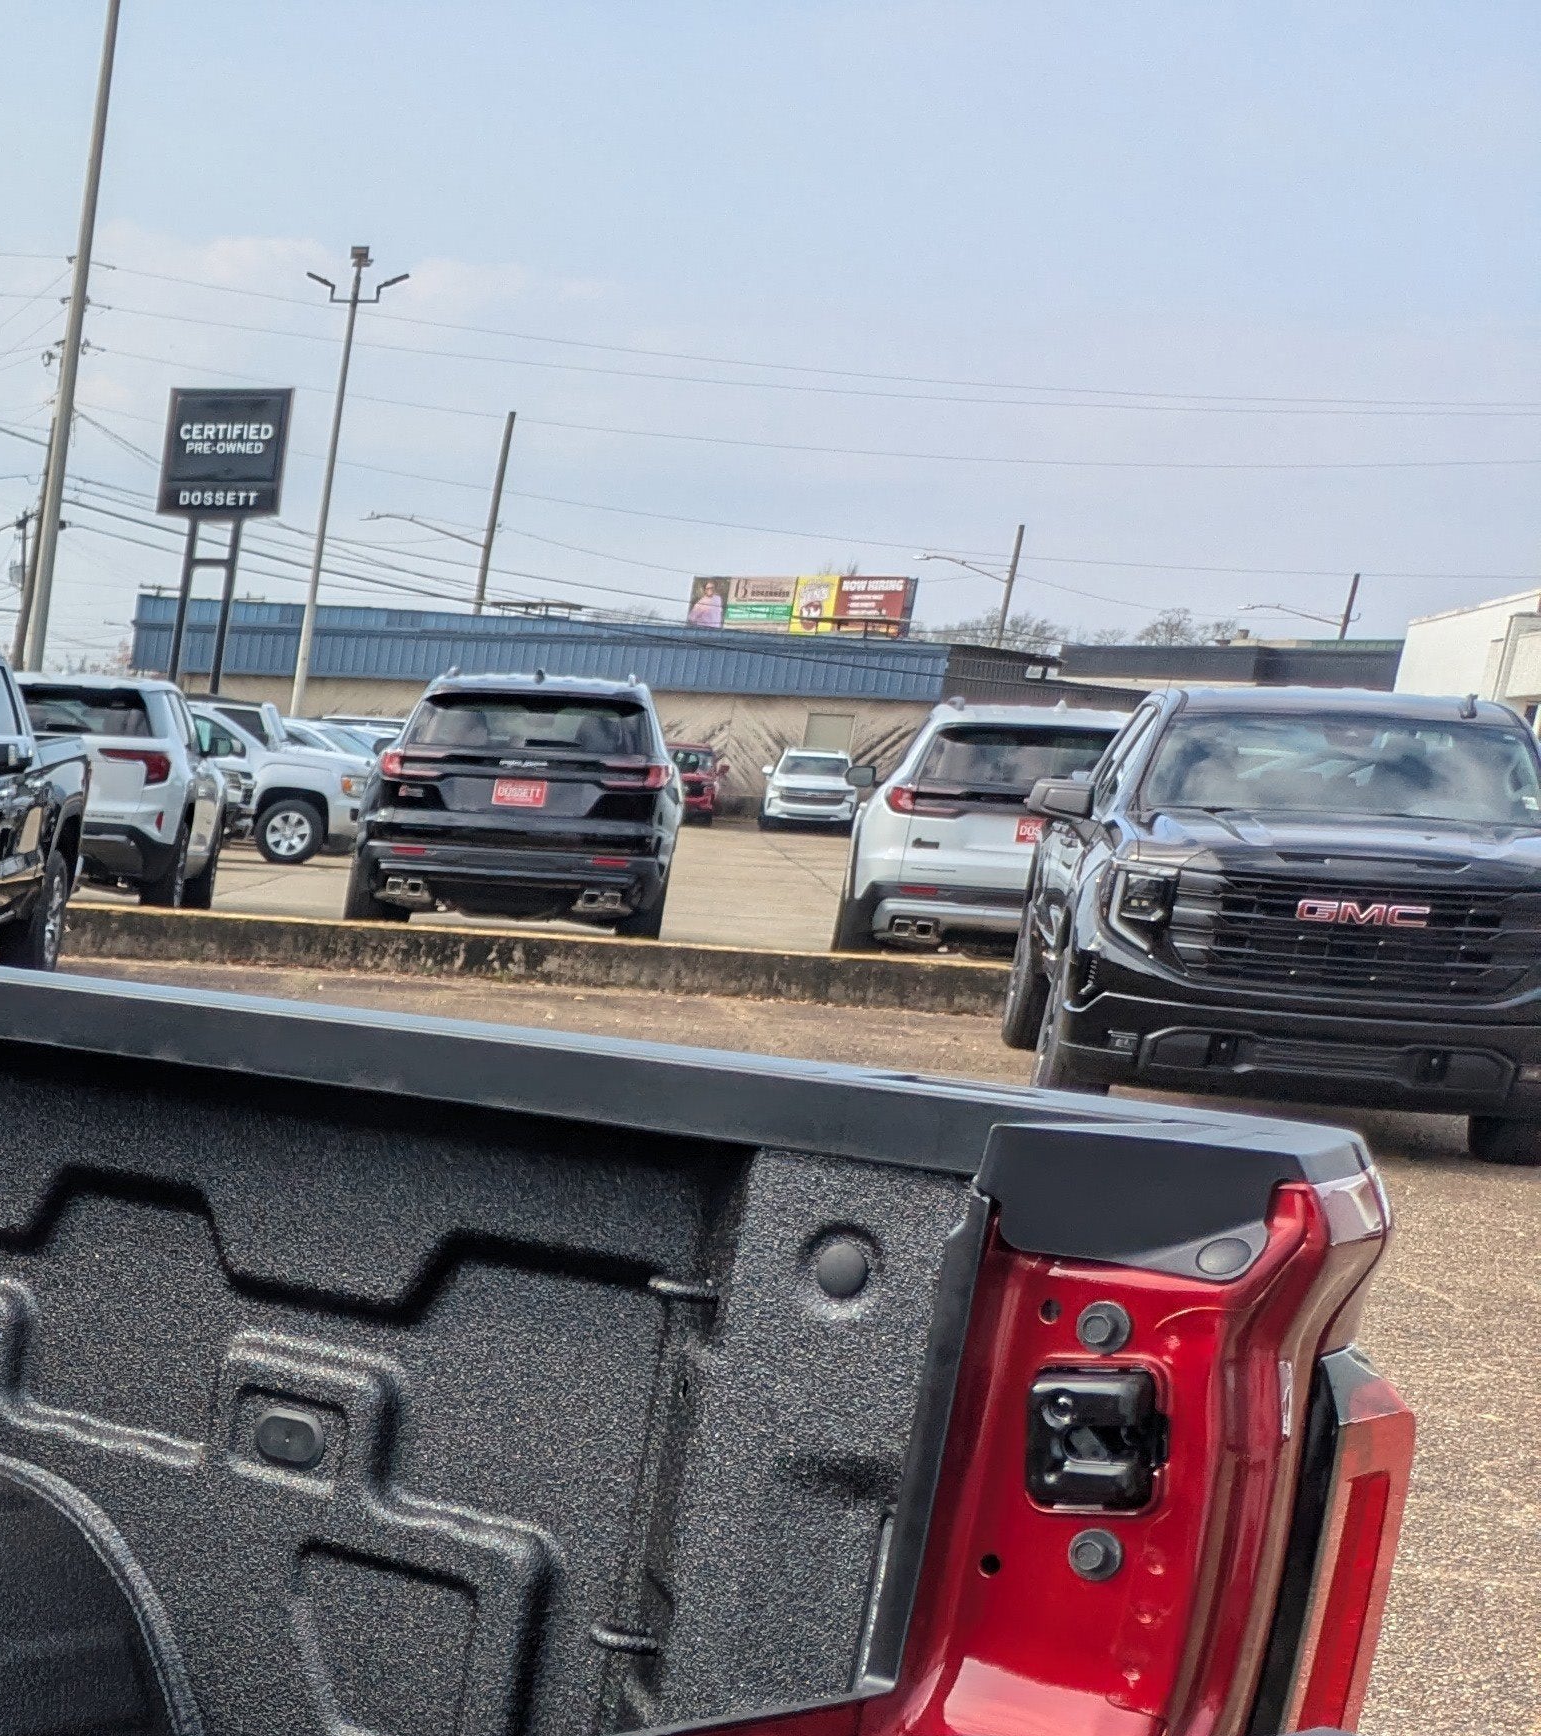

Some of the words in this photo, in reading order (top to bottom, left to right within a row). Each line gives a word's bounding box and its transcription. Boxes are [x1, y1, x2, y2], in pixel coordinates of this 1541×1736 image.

[180, 423, 273, 440] CERTIFIED
[186, 442, 263, 454] PRE-OWNED
[179, 491, 258, 506] DOSSETT
[1296, 899, 1430, 928] GMC
